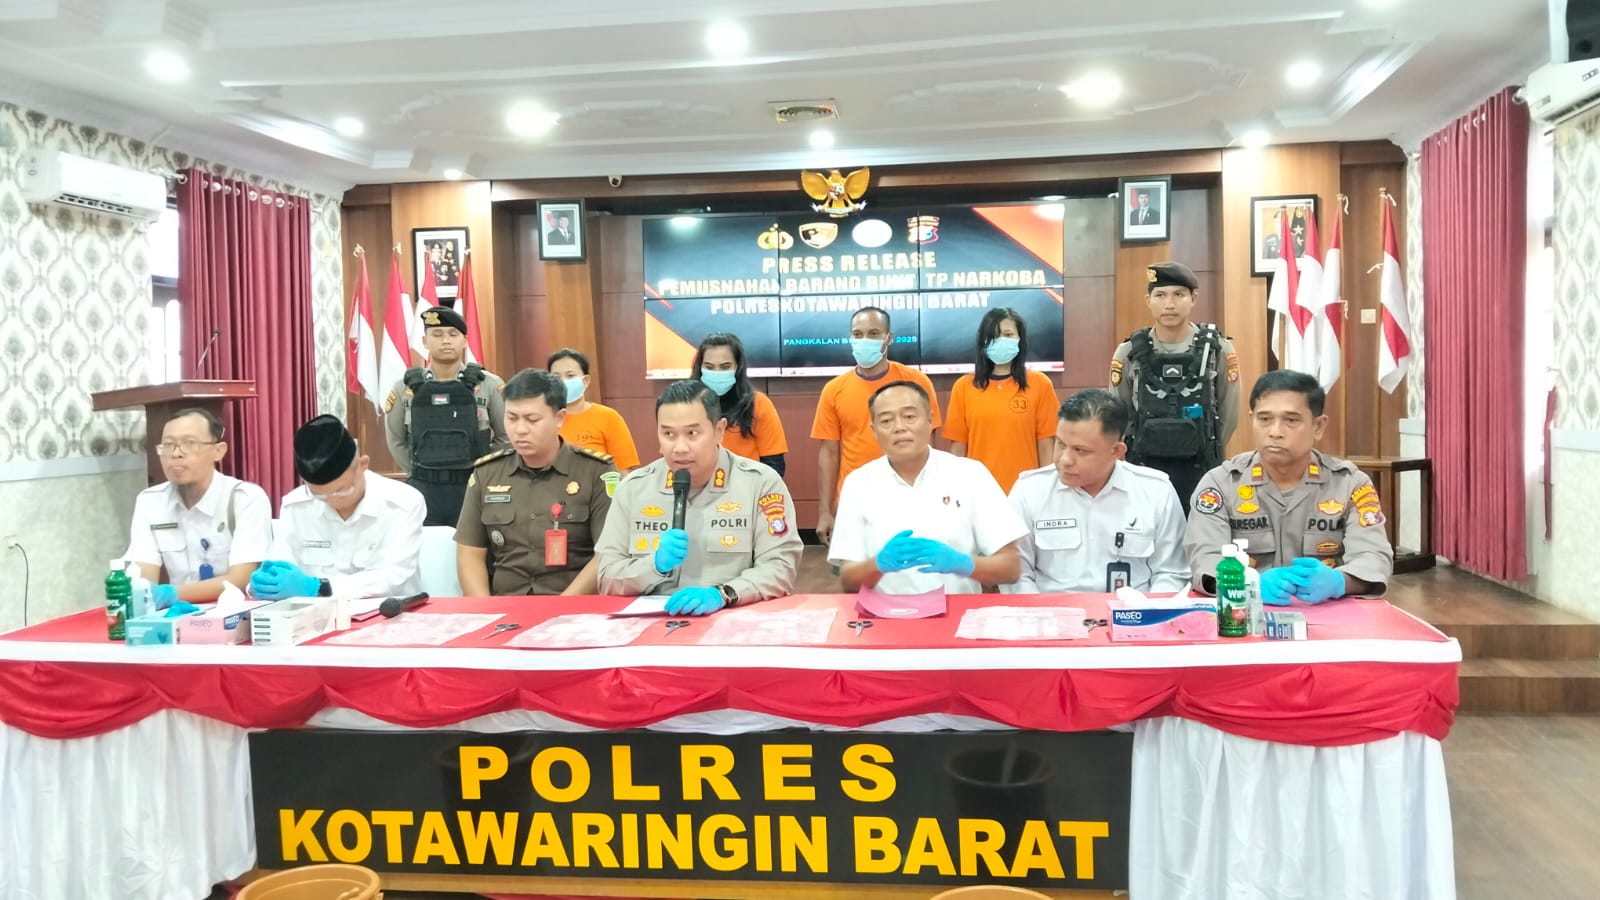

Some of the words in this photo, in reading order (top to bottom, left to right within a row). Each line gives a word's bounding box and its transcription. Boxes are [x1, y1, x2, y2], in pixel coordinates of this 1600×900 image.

[762, 256, 834, 273] PRESS
[840, 251, 937, 272] RELEASE
[785, 275, 861, 293] BARANG
[925, 272, 949, 288] TP
[953, 269, 1046, 287] NARKOBA
[927, 293, 991, 309] BARAT
[783, 338, 840, 346] PANGKALAN
[896, 335, 917, 343] 2025
[1013, 399, 1027, 409] 33
[635, 521, 669, 531] THEO
[711, 518, 747, 528] POLRI
[1115, 611, 1142, 620] PASEO
[460, 743, 897, 803] POLRES
[279, 809, 829, 873] KOTAWARINGIN
[853, 815, 1109, 880] BARAT
